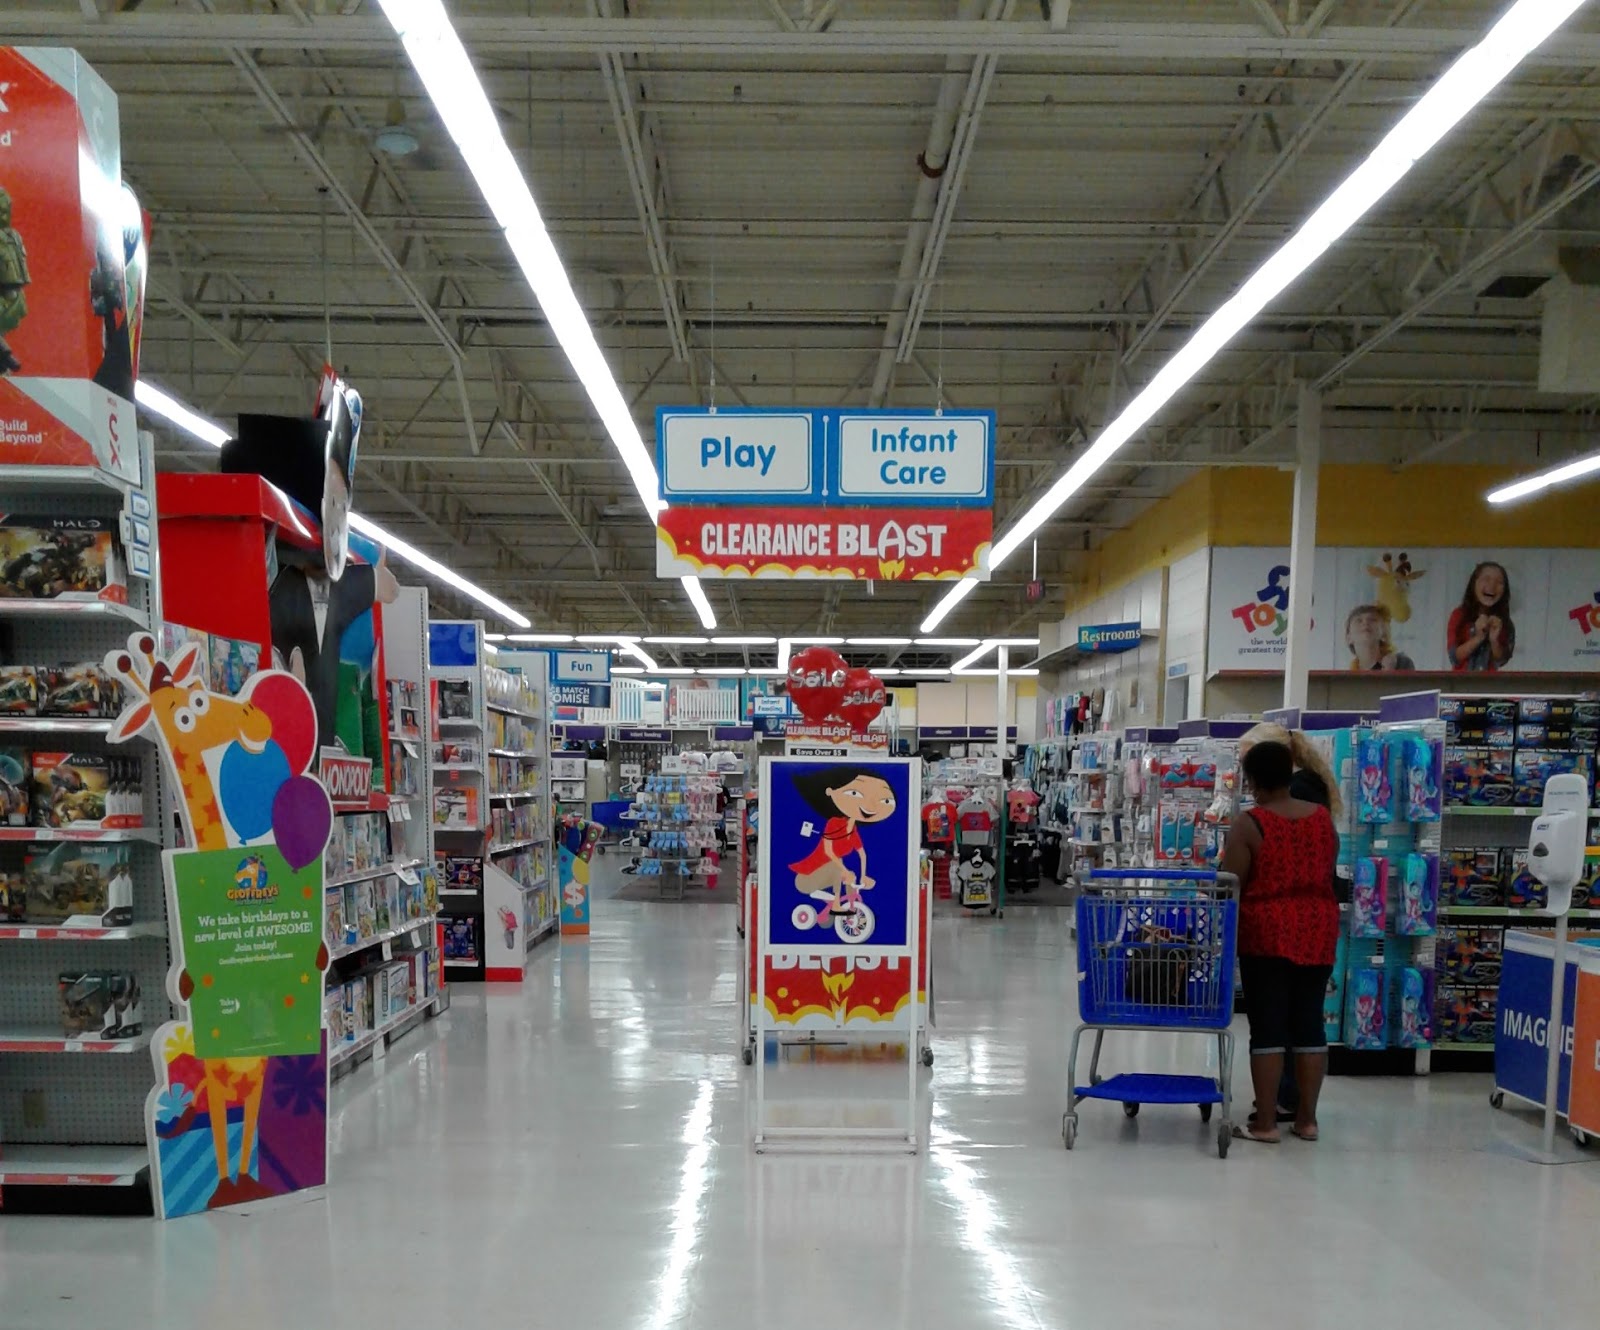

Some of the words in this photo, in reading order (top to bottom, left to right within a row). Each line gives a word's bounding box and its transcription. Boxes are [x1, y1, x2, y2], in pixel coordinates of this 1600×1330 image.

[872, 427, 958, 453] Infant
[700, 436, 776, 476] Play
[880, 460, 947, 485] Care
[53, 519, 101, 528] HALO
[701, 523, 831, 556] CLEARANCE
[838, 519, 947, 558] BLAST
[1231, 602, 1290, 637] Toy
[1080, 628, 1141, 644] Restrooms
[1250, 637, 1264, 645] the
[1265, 637, 1288, 645] world
[1238, 646, 1271, 655] greatest
[570, 660, 593, 672] Fun
[789, 667, 846, 688] Sale
[562, 686, 590, 695] MATCH
[552, 693, 590, 704] OMISE
[787, 726, 821, 736] CLEARANCE
[822, 726, 851, 737] BLAST
[862, 733, 888, 743] BLAST
[796, 748, 814, 756] Save
[815, 748, 832, 756] Over
[72, 757, 104, 765] HALO
[322, 763, 370, 796] MONOPOLY
[198, 916, 216, 927] We
[217, 913, 240, 926] take
[241, 909, 289, 924] birthdays
[290, 910, 301, 920] to
[302, 910, 309, 919] a
[194, 932, 216, 943] new
[217, 926, 242, 941] level
[243, 925, 255, 938] of
[256, 921, 313, 938] AWESOME!
[234, 942, 252, 953] Join
[254, 940, 278, 952] today!
